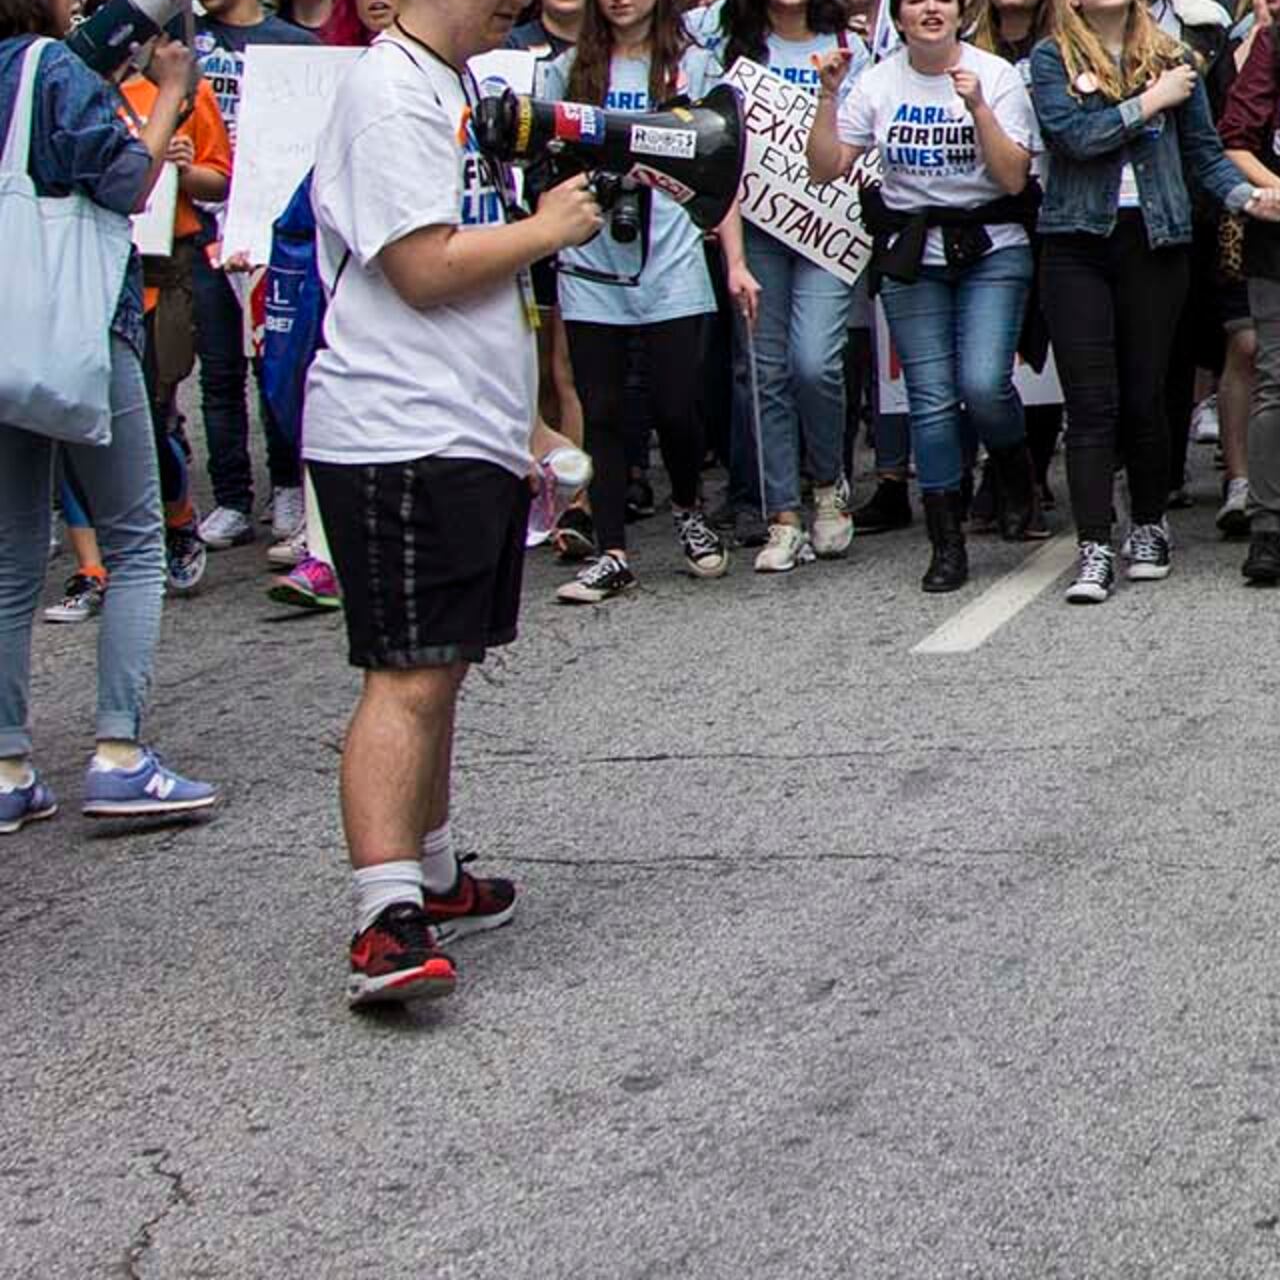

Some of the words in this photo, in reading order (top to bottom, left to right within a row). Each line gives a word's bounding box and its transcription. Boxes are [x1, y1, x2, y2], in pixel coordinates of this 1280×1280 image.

[605, 92, 646, 109] ARC
[887, 126, 930, 145] FOR
[932, 126, 975, 144] OUR
[887, 146, 945, 166] LIVES
[740, 174, 873, 272] SISTANCE
